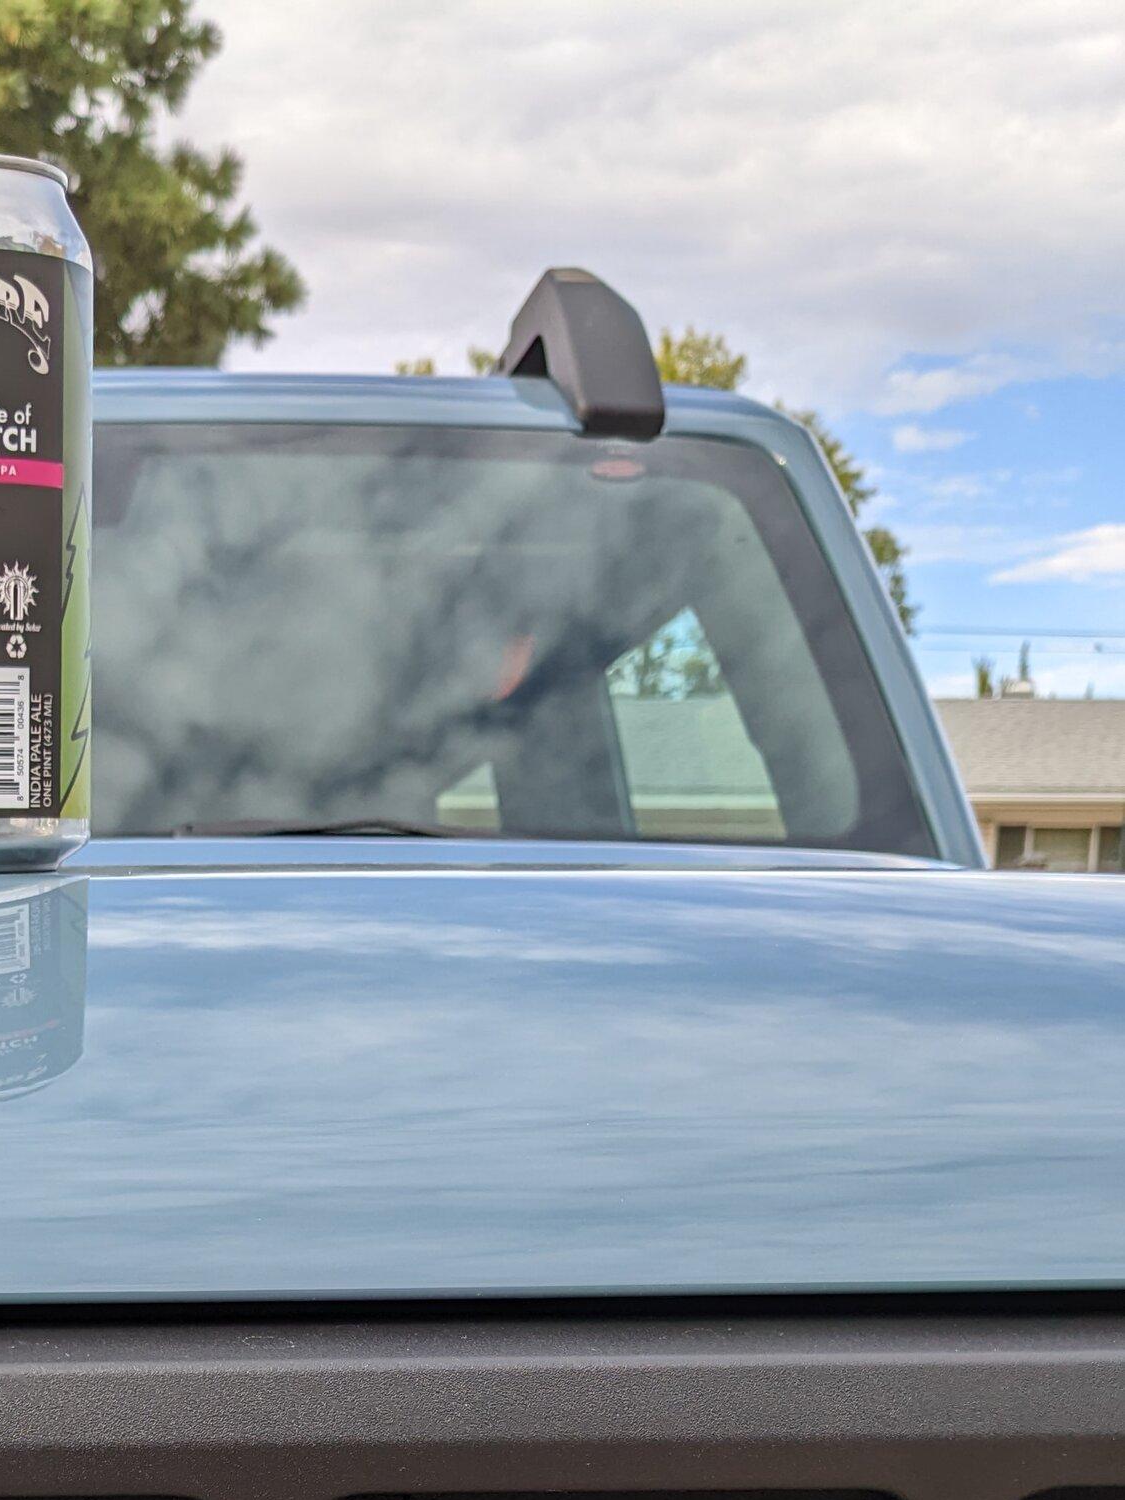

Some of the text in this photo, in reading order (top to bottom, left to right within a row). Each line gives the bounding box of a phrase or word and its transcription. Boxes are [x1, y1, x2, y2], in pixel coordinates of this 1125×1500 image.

[14, 403, 32, 425] of
[16, 622, 24, 634] by
[25, 622, 42, 632] Solar
[30, 694, 42, 808] INDIA PALE ALE
[43, 694, 53, 807] ONE PINT (473 ML)
